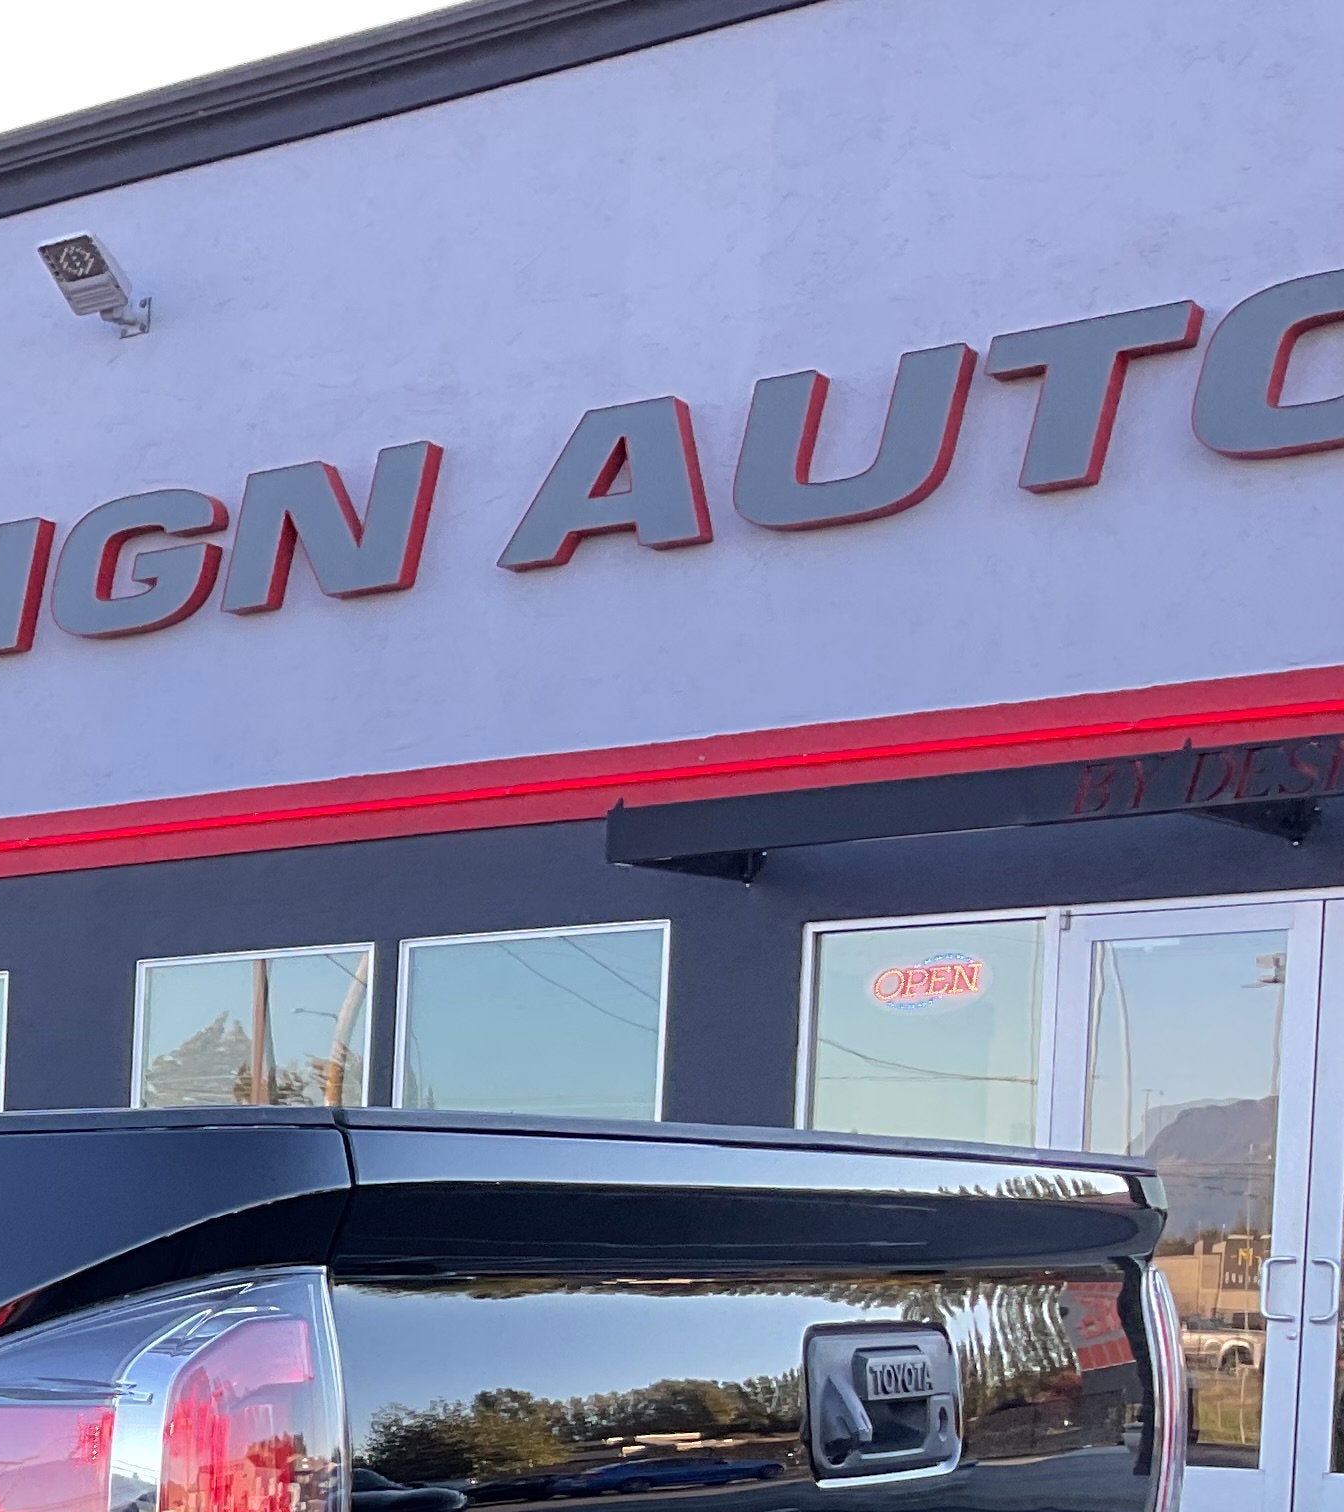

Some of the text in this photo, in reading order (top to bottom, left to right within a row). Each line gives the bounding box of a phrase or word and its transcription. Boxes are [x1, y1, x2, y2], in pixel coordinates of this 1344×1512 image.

[1072, 754, 1168, 815] BY
[873, 960, 985, 1002] OPEN
[868, 1361, 934, 1396] TOYOTA
